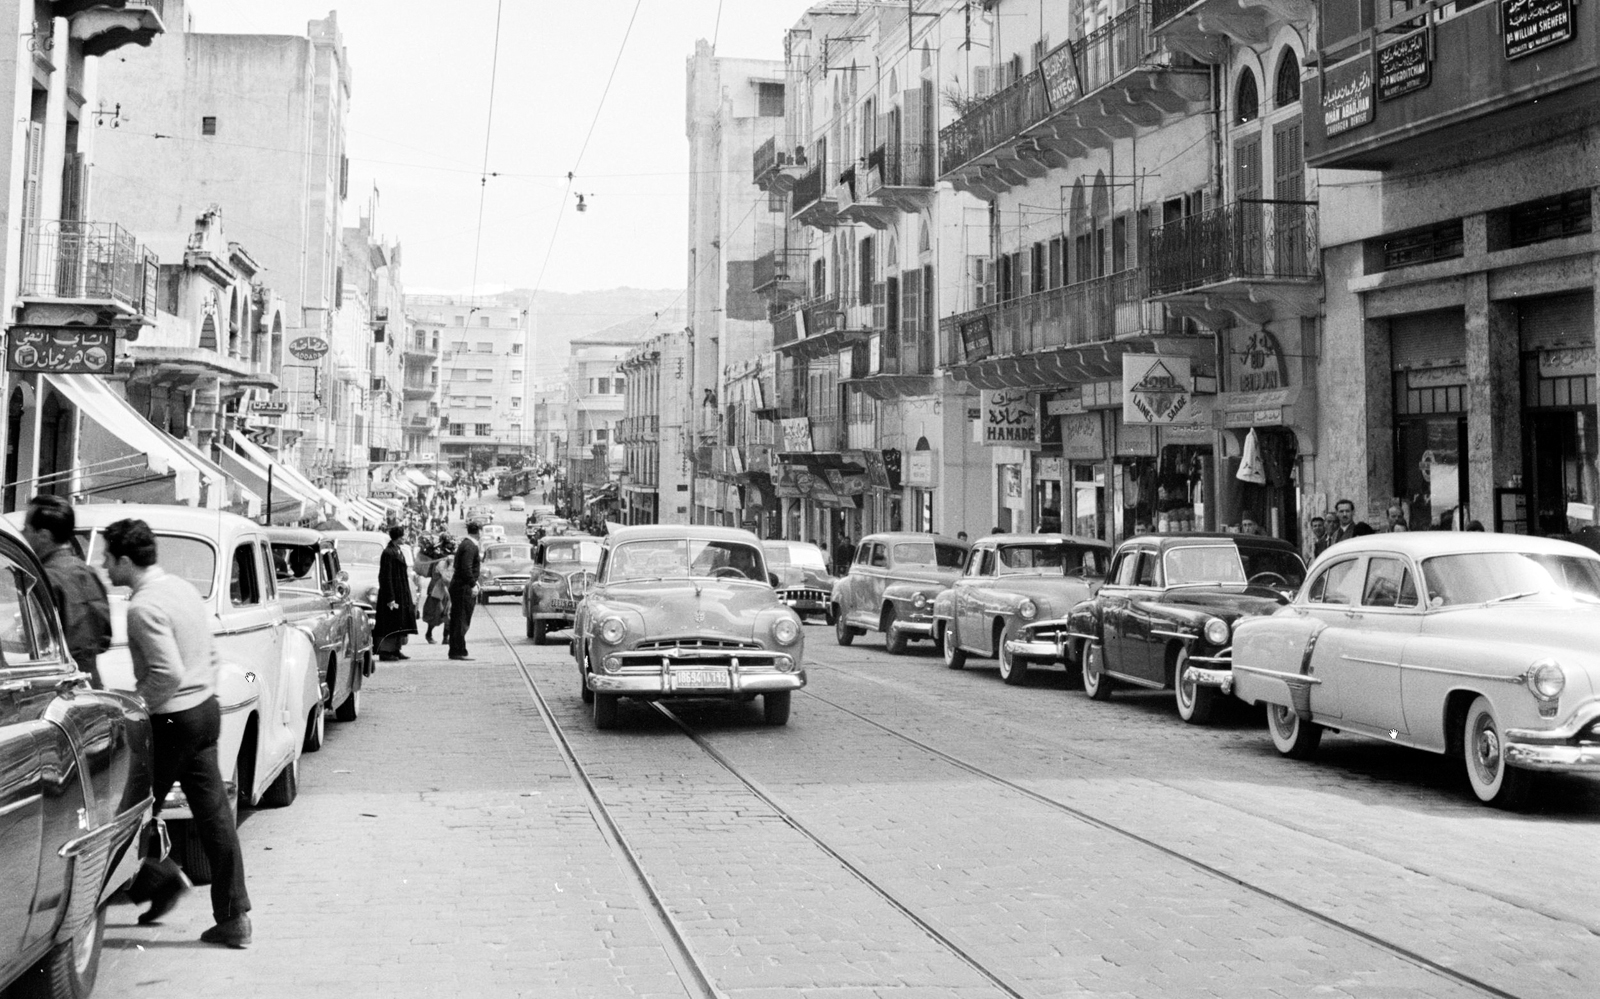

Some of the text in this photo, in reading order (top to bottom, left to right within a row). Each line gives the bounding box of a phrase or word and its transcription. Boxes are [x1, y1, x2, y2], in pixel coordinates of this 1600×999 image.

[1514, 24, 1537, 41] WILLIAM
[1133, 394, 1154, 423] LAINES
[678, 672, 701, 683] 18694
